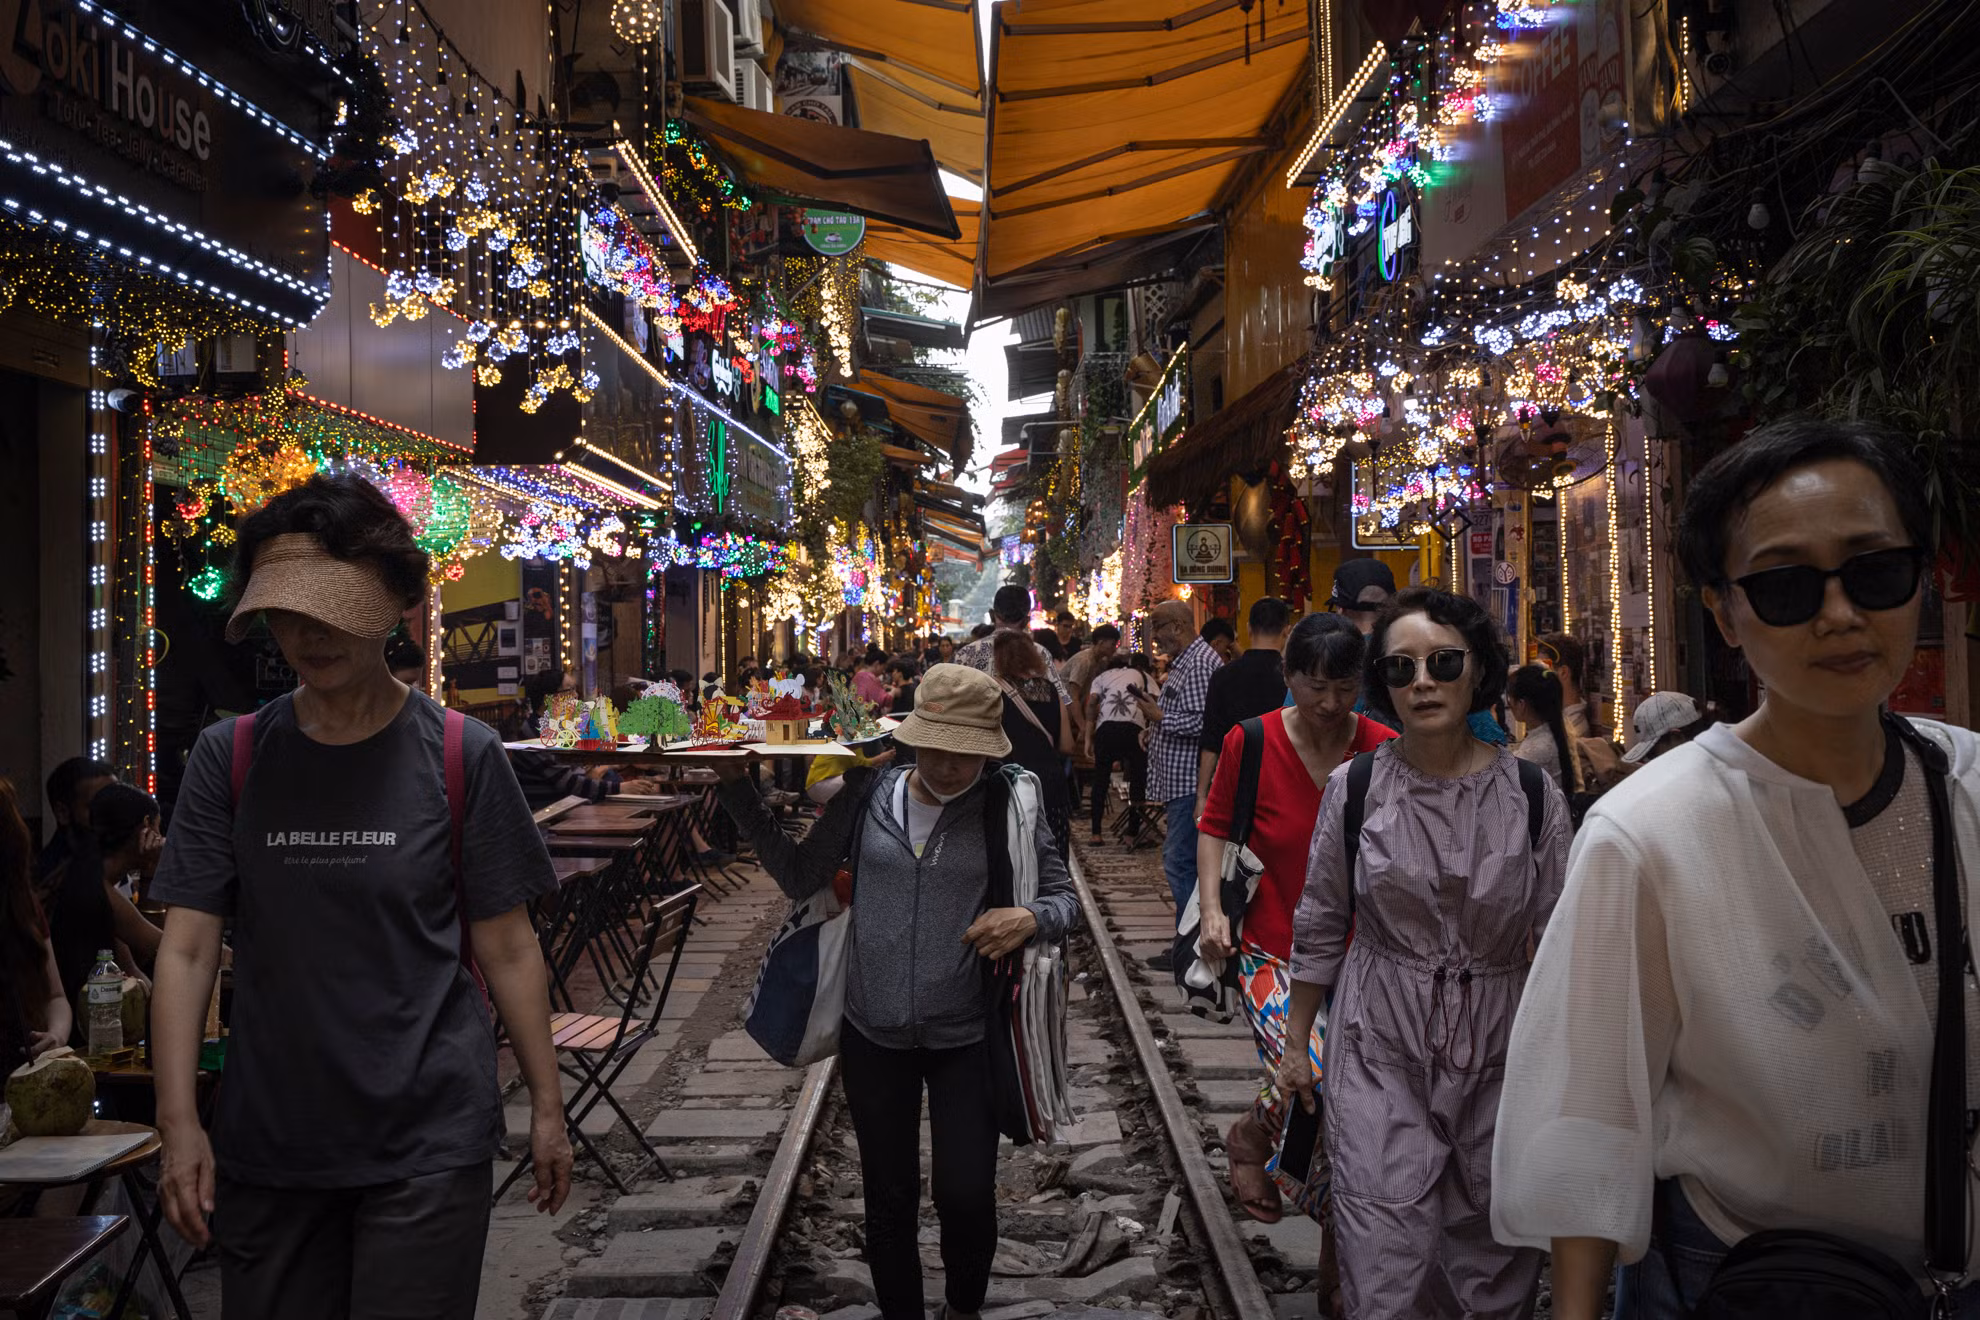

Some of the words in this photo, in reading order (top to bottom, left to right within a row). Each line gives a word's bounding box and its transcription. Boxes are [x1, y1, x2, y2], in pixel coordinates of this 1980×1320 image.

[111, 39, 211, 160] House
[266, 832, 287, 846] LA
[289, 831, 340, 846] BELLE
[342, 831, 397, 846] FLEUR
[301, 855, 309, 865] le
[309, 856, 329, 868] plus
[329, 855, 368, 868] parfumé
